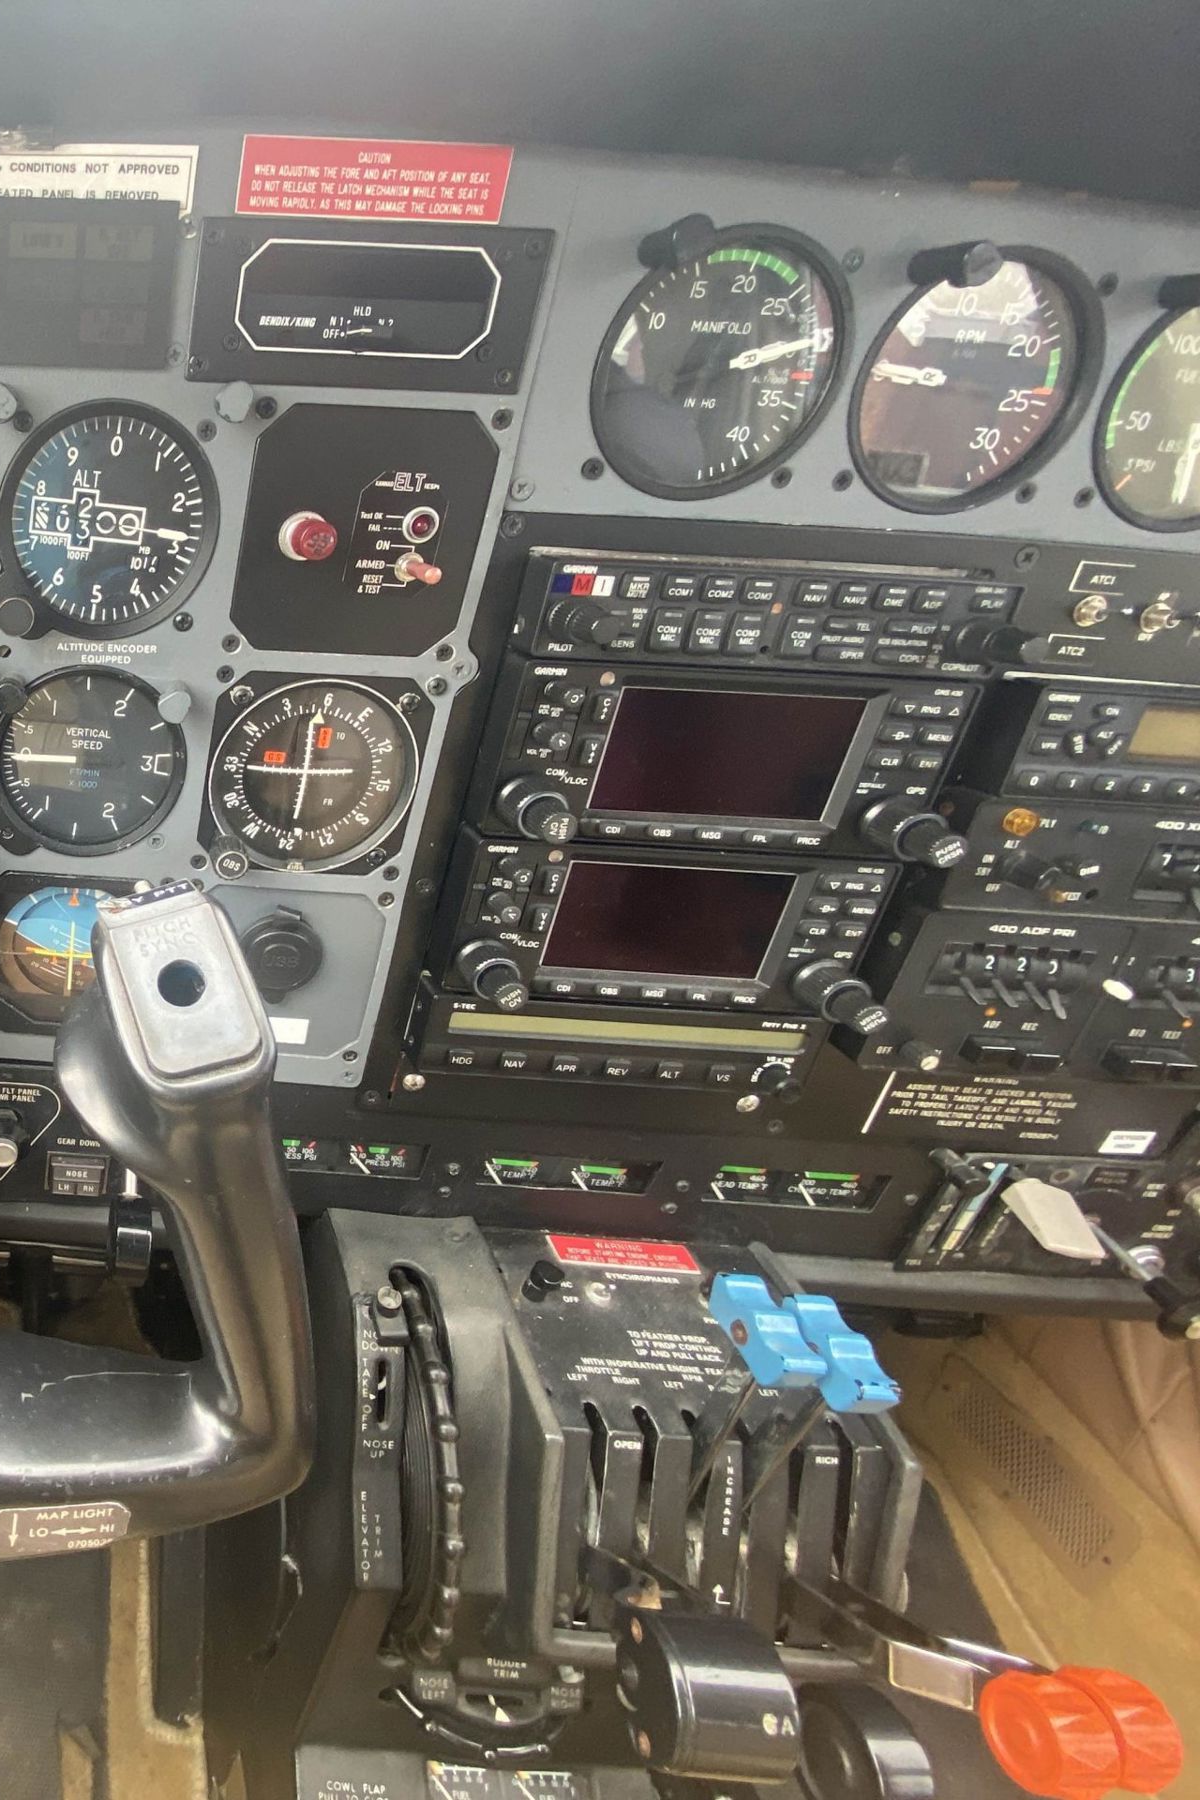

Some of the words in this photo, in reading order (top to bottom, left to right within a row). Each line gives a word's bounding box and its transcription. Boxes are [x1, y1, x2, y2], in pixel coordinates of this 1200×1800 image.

[358, 152, 392, 164] CAUTION
[10, 162, 76, 173] CONDITIONS
[85, 163, 109, 174] NOT
[119, 164, 180, 175] APPROVED
[254, 164, 276, 176] WHEN
[279, 165, 320, 178] ADJUSTING
[323, 166, 338, 179] THE
[341, 167, 361, 179] FORE
[364, 168, 380, 180] AND
[382, 169, 397, 181] AFT
[400, 169, 436, 182] POSITION
[438, 171, 448, 183] OF
[451, 171, 466, 184] ANY
[86, 190, 96, 199] IS
[105, 190, 159, 200] REMOVED
[251, 180, 261, 191] DO
[264, 180, 280, 192] NOT
[282, 181, 317, 193] RELEASE
[321, 182, 335, 194] THE
[338, 183, 362, 195] LATCH
[365, 184, 410, 197] MECHANISM
[413, 185, 437, 198] WHILE
[440, 186, 455, 199] THE
[458, 187, 477, 200] SEAT
[480, 188, 489, 200] IS
[249, 196, 279, 208] MOVING
[320, 198, 331, 210] AS
[334, 199, 352, 210] THIS
[355, 199, 372, 211] MAY
[375, 200, 407, 212] DAMAGE
[411, 201, 426, 214] THE
[428, 202, 463, 215] LOCKING
[465, 203, 484, 216] PINS
[690, 280, 708, 298] 15
[731, 275, 756, 294] 20
[760, 298, 787, 316] 25
[955, 294, 977, 316] 10
[353, 306, 371, 317] HLD
[259, 316, 316, 328] BENDIX/KING
[649, 313, 665, 330] 10
[690, 321, 751, 335] MANIFOLD
[323, 329, 339, 339] OFF
[954, 329, 986, 344] RPM
[1008, 335, 1040, 357] 20
[684, 398, 696, 408] IN
[701, 398, 716, 409] HG
[757, 390, 783, 407] 35
[998, 390, 1031, 412] 25
[1125, 411, 1151, 431] 50
[726, 426, 750, 442] 40
[969, 428, 1000, 450] 30
[73, 469, 101, 489] ALT
[393, 472, 427, 492] ELT
[360, 511, 373, 520] Test
[374, 512, 383, 520] OK
[368, 524, 381, 532] FAIL
[376, 540, 390, 551] ON
[355, 560, 385, 569] ARMED
[563, 565, 598, 574] GARMIN
[362, 574, 383, 584] RESET
[1090, 575, 1116, 585] ATC1
[364, 585, 380, 595] TEST
[668, 588, 693, 597] COM1
[708, 590, 734, 599] COM2
[747, 591, 773, 600] COM3
[803, 594, 826, 602] NAV1
[843, 596, 867, 605] NAV2
[883, 599, 904, 607] DME
[922, 601, 942, 609] ADF
[980, 599, 1003, 609] PLAY
[657, 625, 682, 634] COM1
[660, 633, 676, 642] MIC
[57, 642, 104, 653] ALTITUDE
[107, 643, 157, 654] ENCODER
[548, 643, 572, 651] PILOT
[611, 640, 634, 649] SENS
[840, 651, 864, 660] SPKR
[1057, 646, 1084, 656] ATC2
[81, 654, 131, 665] EQUIPPED
[534, 667, 567, 676] GARMIN
[941, 662, 980, 672] COPILOT
[921, 705, 941, 714] RNG
[65, 727, 111, 739] VERTICAL
[928, 733, 952, 742] MENU
[71, 739, 103, 750] SPEED
[881, 758, 898, 766] CLR
[919, 760, 937, 768] ENT
[906, 786, 926, 795] GPS
[605, 826, 620, 834] CDI
[653, 829, 671, 837] OBS
[702, 831, 721, 840] MSG
[752, 835, 767, 843] FPL
[797, 837, 821, 846] PROC
[223, 859, 240, 871] OBS
[989, 924, 1018, 934] 400
[1021, 926, 1050, 936] ADF
[1053, 928, 1077, 938] PRI
[451, 1056, 472, 1065] HDG
[504, 1060, 525, 1069] NAV
[555, 1064, 576, 1073] APR
[607, 1067, 628, 1076] REV
[660, 1071, 680, 1080] ALT
[716, 1074, 730, 1082] VS
[57, 1137, 77, 1146] GEAR
[79, 1138, 100, 1148] DOWN
[66, 1170, 88, 1178] NOSE
[606, 1272, 679, 1284] SYNCHROPHASER
[641, 1331, 681, 1342] FEATHER
[575, 1365, 622, 1376] THROTTLE
[566, 1372, 588, 1382] LEFT
[611, 1376, 641, 1385] RIGHT
[362, 1439, 395, 1449] NOSE
[613, 1440, 641, 1449] OPEN
[370, 1450, 384, 1458] UP
[814, 1456, 839, 1465] RICH
[36, 1510, 69, 1520] MAP
[73, 1508, 114, 1519] LIGHT
[28, 1528, 49, 1538] LO
[99, 1523, 115, 1533] HI
